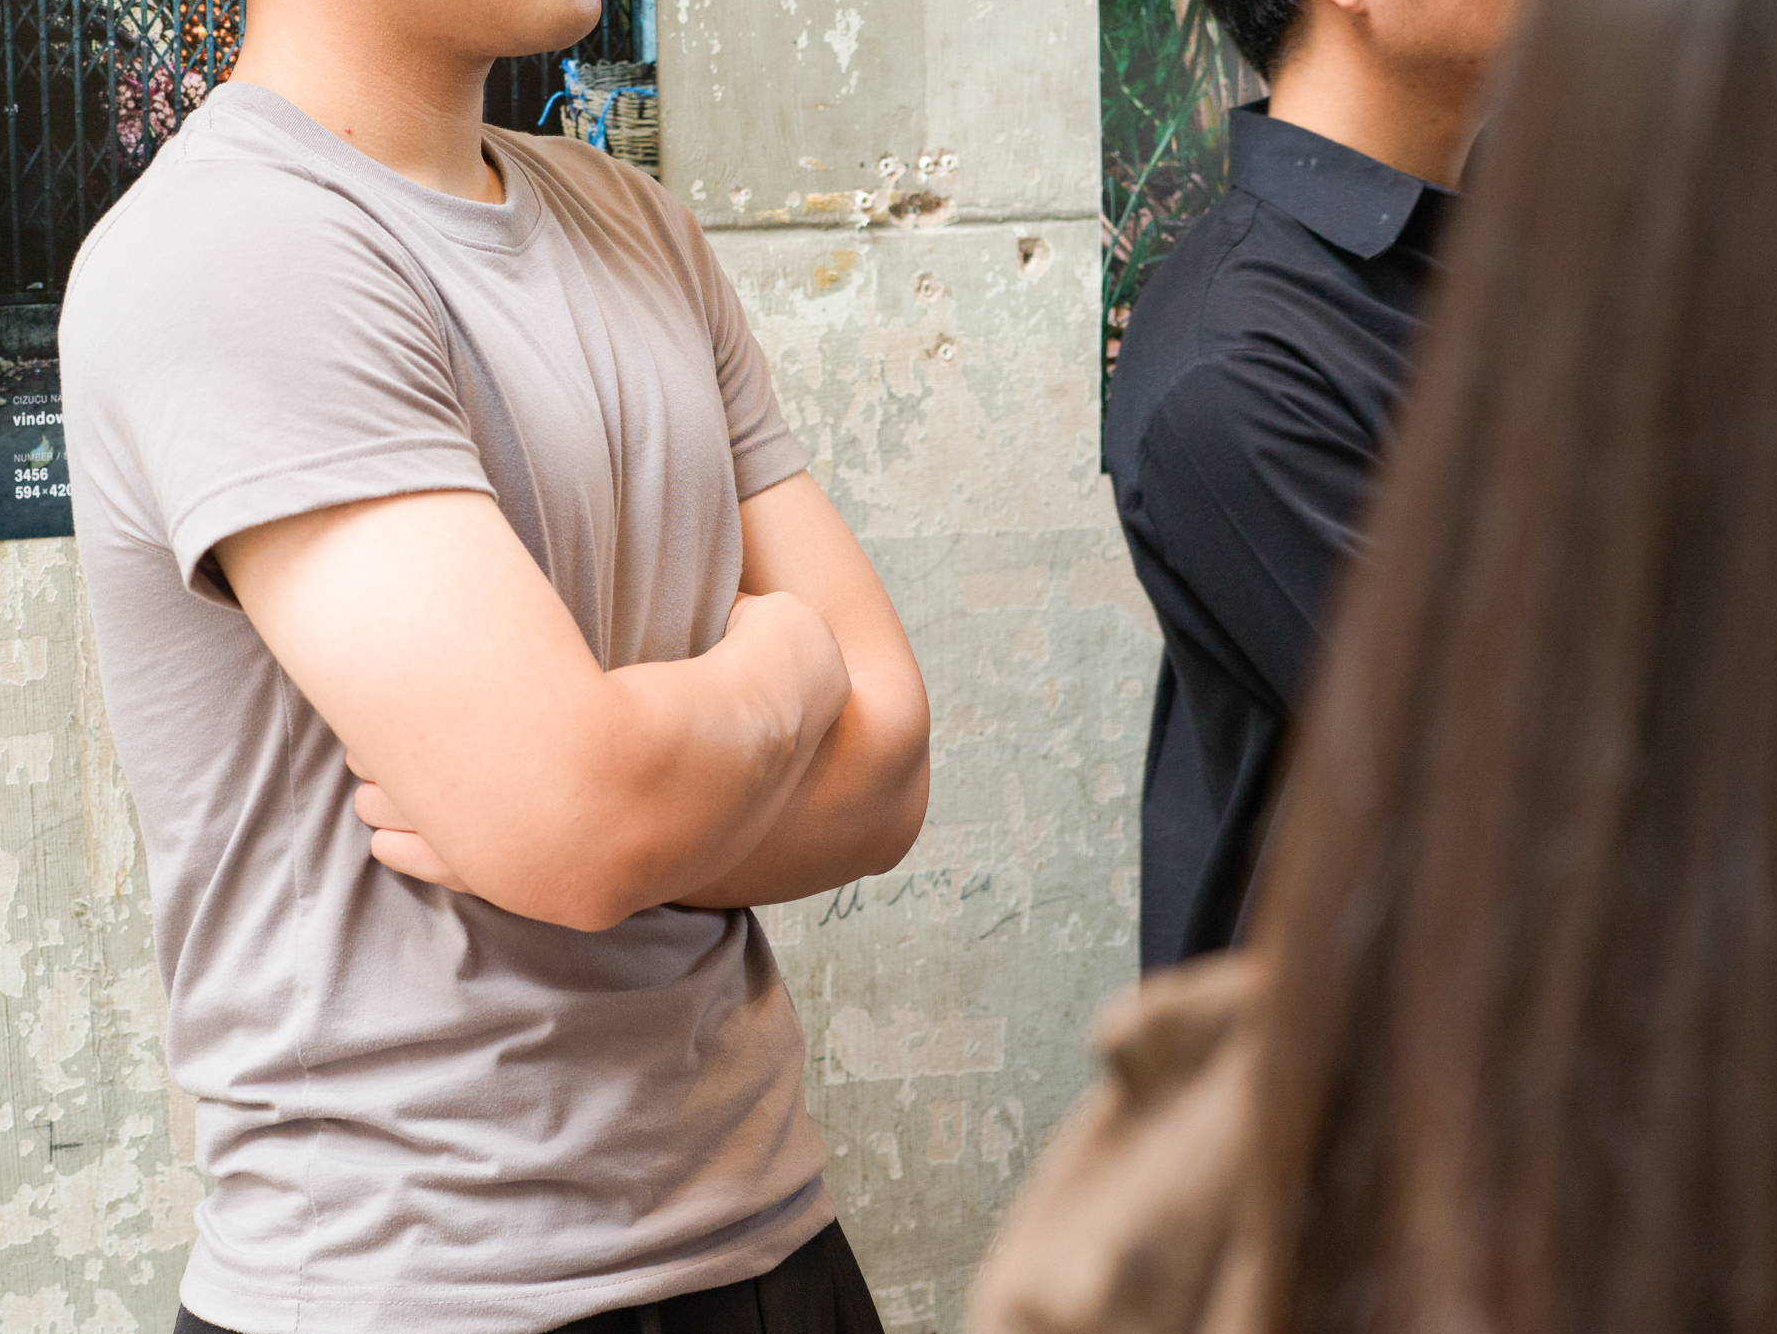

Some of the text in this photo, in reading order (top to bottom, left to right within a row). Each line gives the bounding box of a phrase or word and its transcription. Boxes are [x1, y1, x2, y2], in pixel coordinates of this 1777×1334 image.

[12, 395, 48, 406] CIZUCU
[13, 451, 54, 463] NUMBER
[14, 467, 49, 483] 3456
